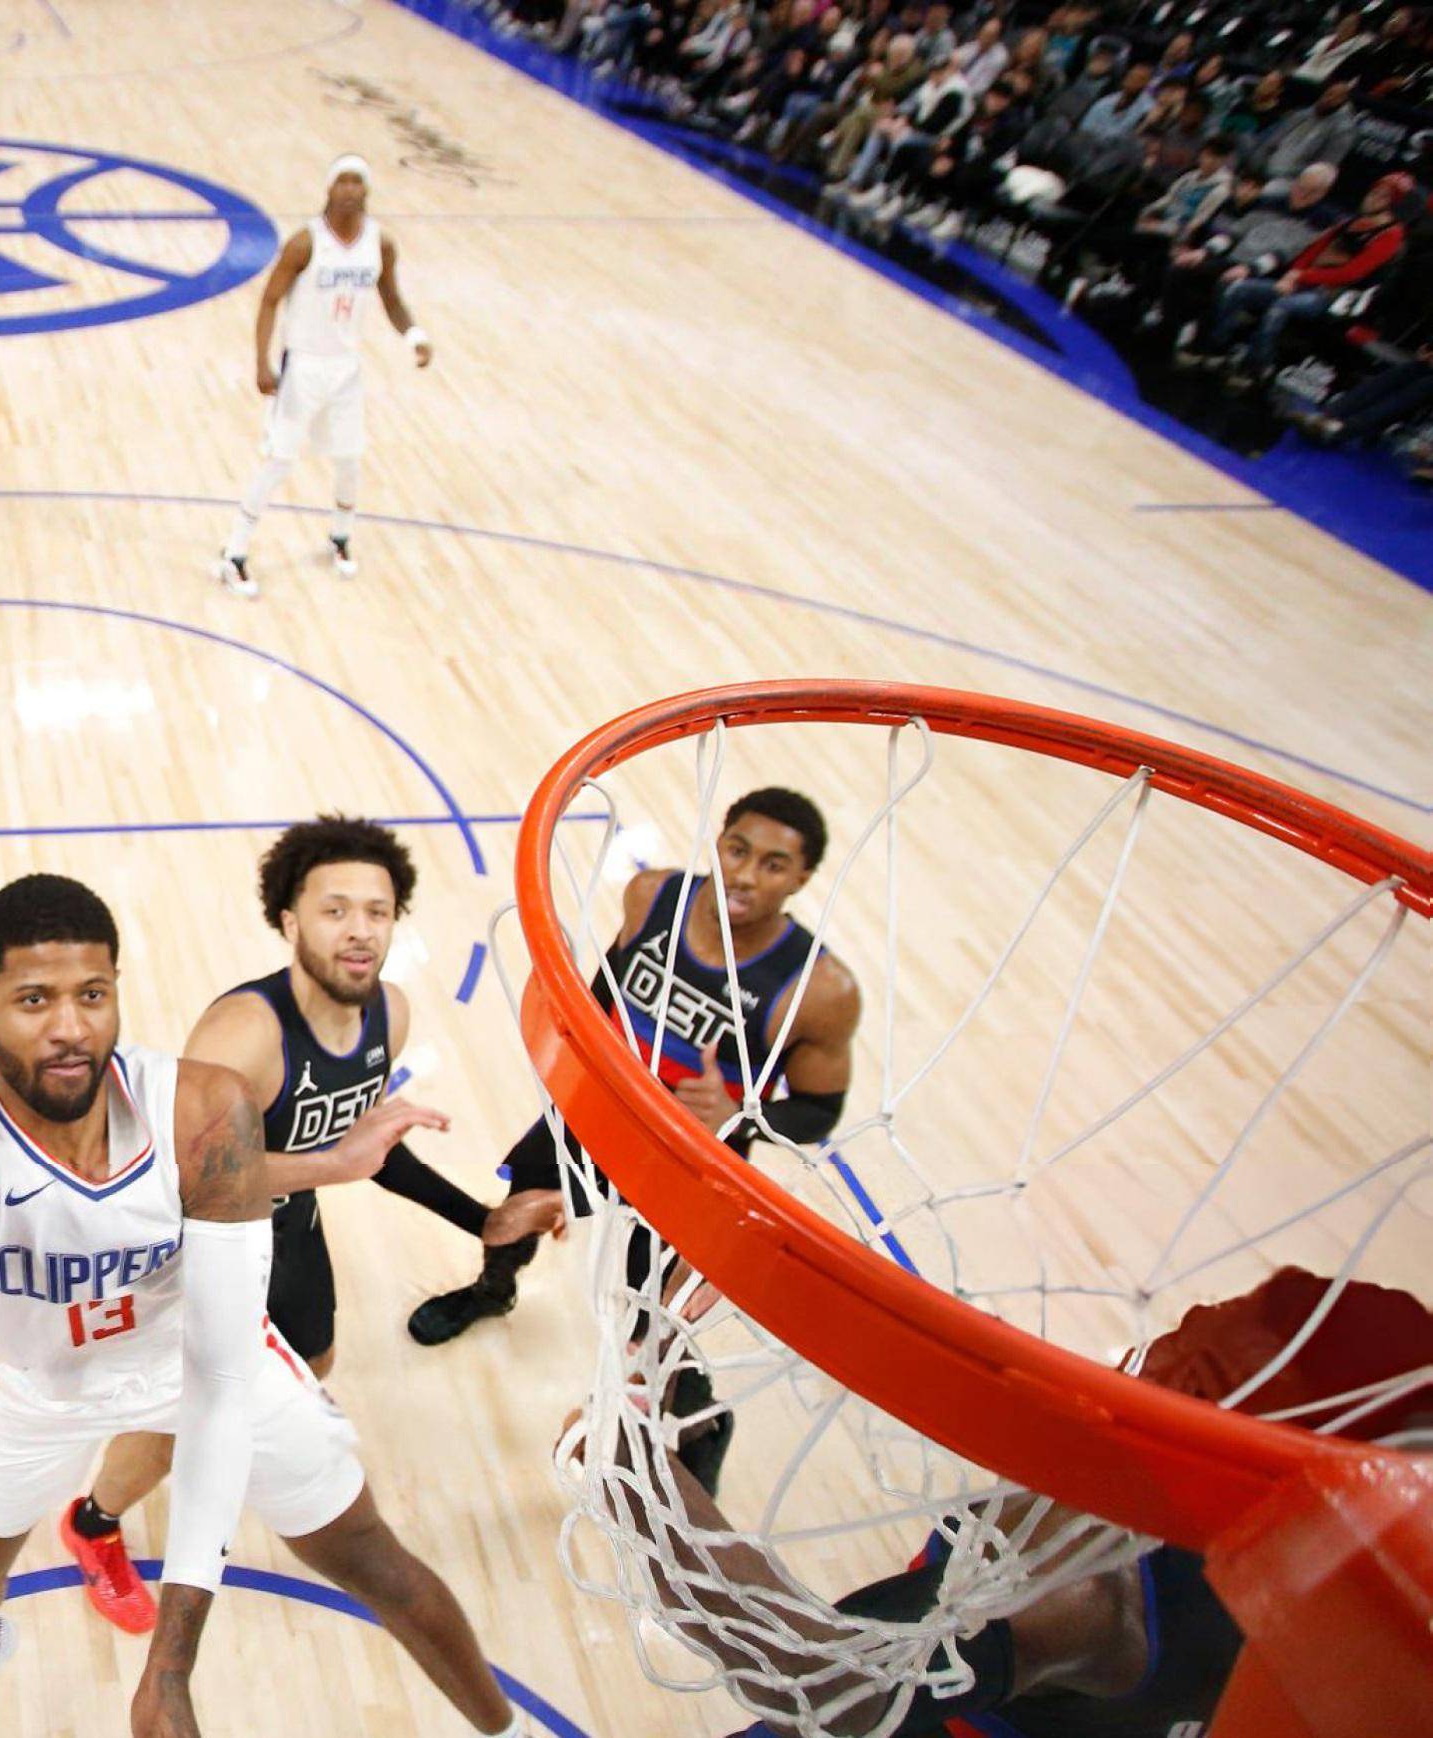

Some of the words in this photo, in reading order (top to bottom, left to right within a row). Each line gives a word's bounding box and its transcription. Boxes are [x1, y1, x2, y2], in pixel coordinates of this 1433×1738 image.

[620, 950, 747, 1050] DET
[285, 1073, 385, 1152] DET
[67, 1293, 136, 1348] 13
